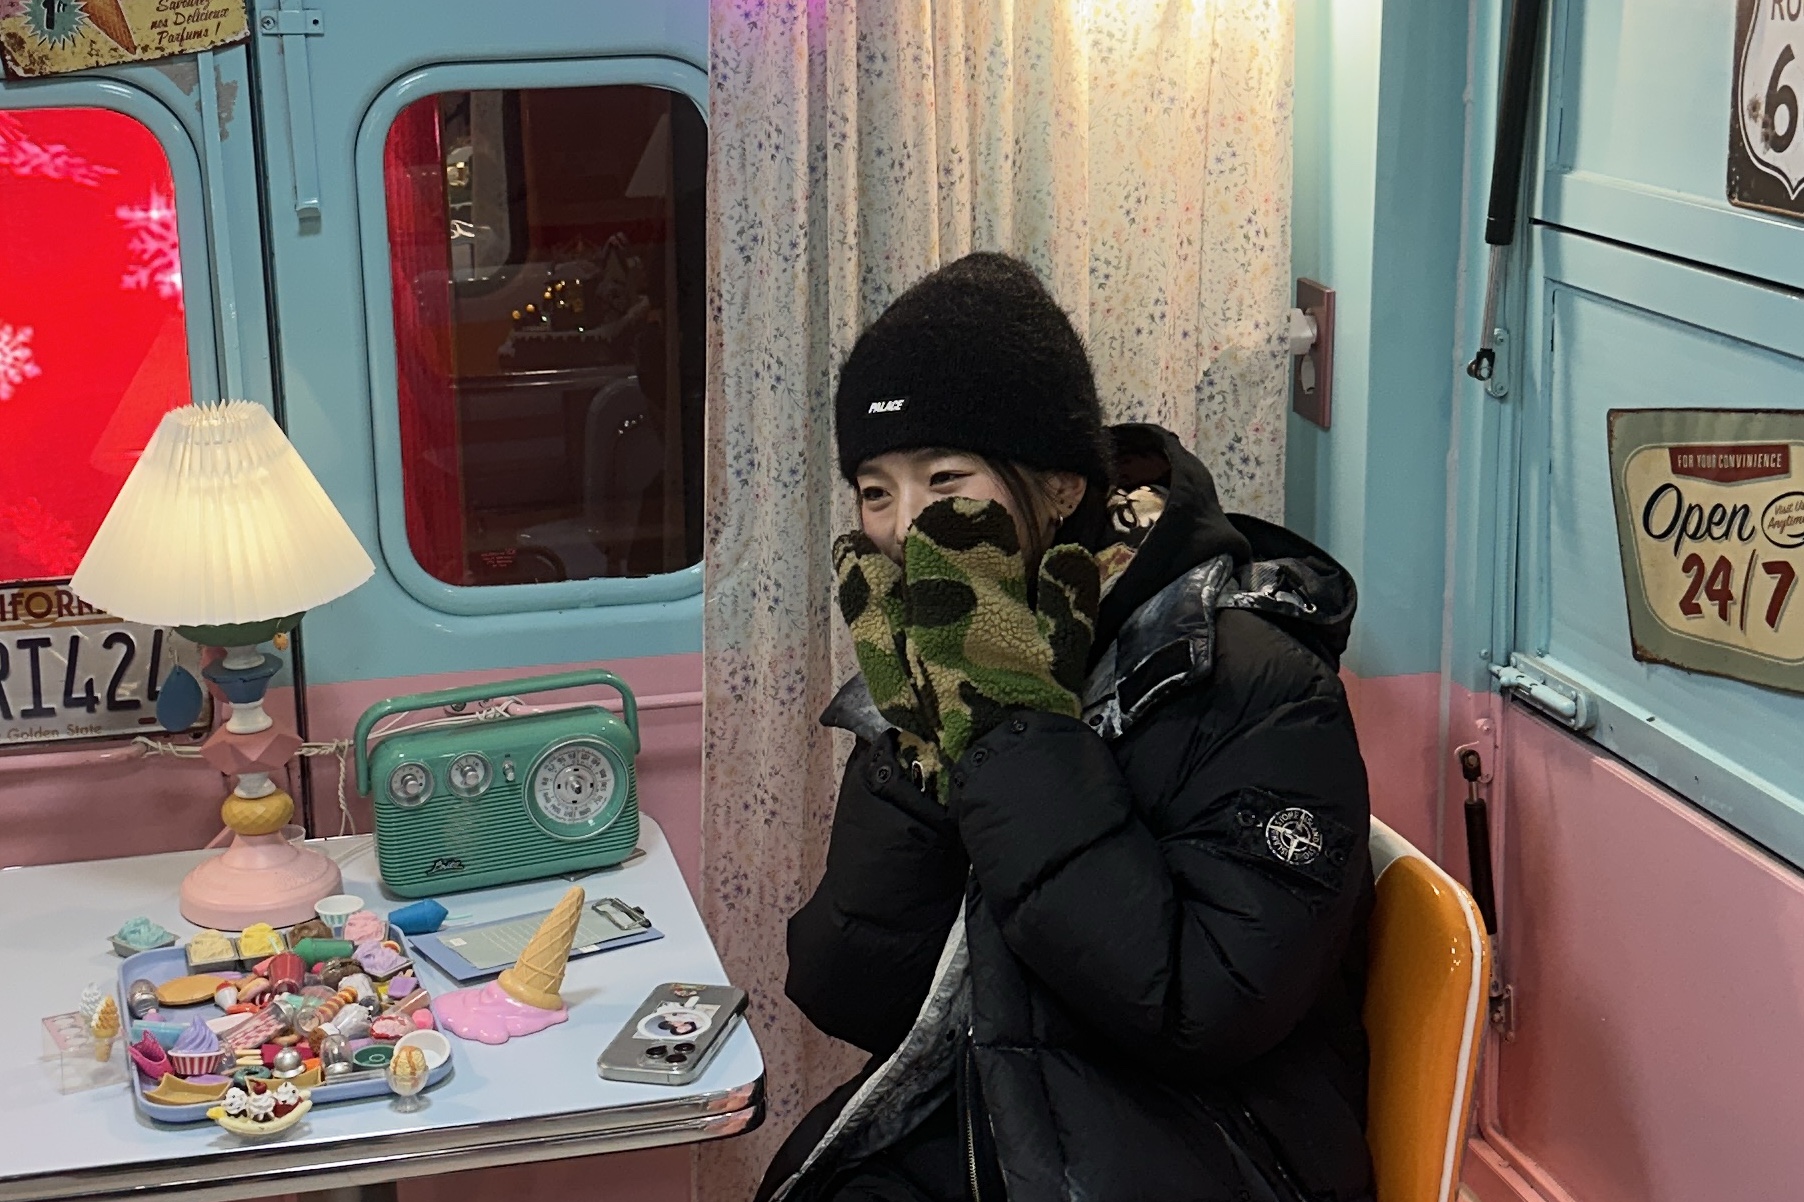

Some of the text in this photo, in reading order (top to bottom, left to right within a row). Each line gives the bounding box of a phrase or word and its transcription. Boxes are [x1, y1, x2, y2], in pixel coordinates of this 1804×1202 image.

[151, 18, 169, 30] nos
[157, 26, 209, 47] Parfums
[868, 399, 905, 414] PALACE
[1677, 454, 1694, 469] FOR
[1696, 454, 1717, 469] YOUR
[1774, 502, 1794, 516] Visit
[1642, 482, 1756, 558] Open
[1678, 548, 1797, 632] 24/7
[7, 723, 103, 740] Golden State
